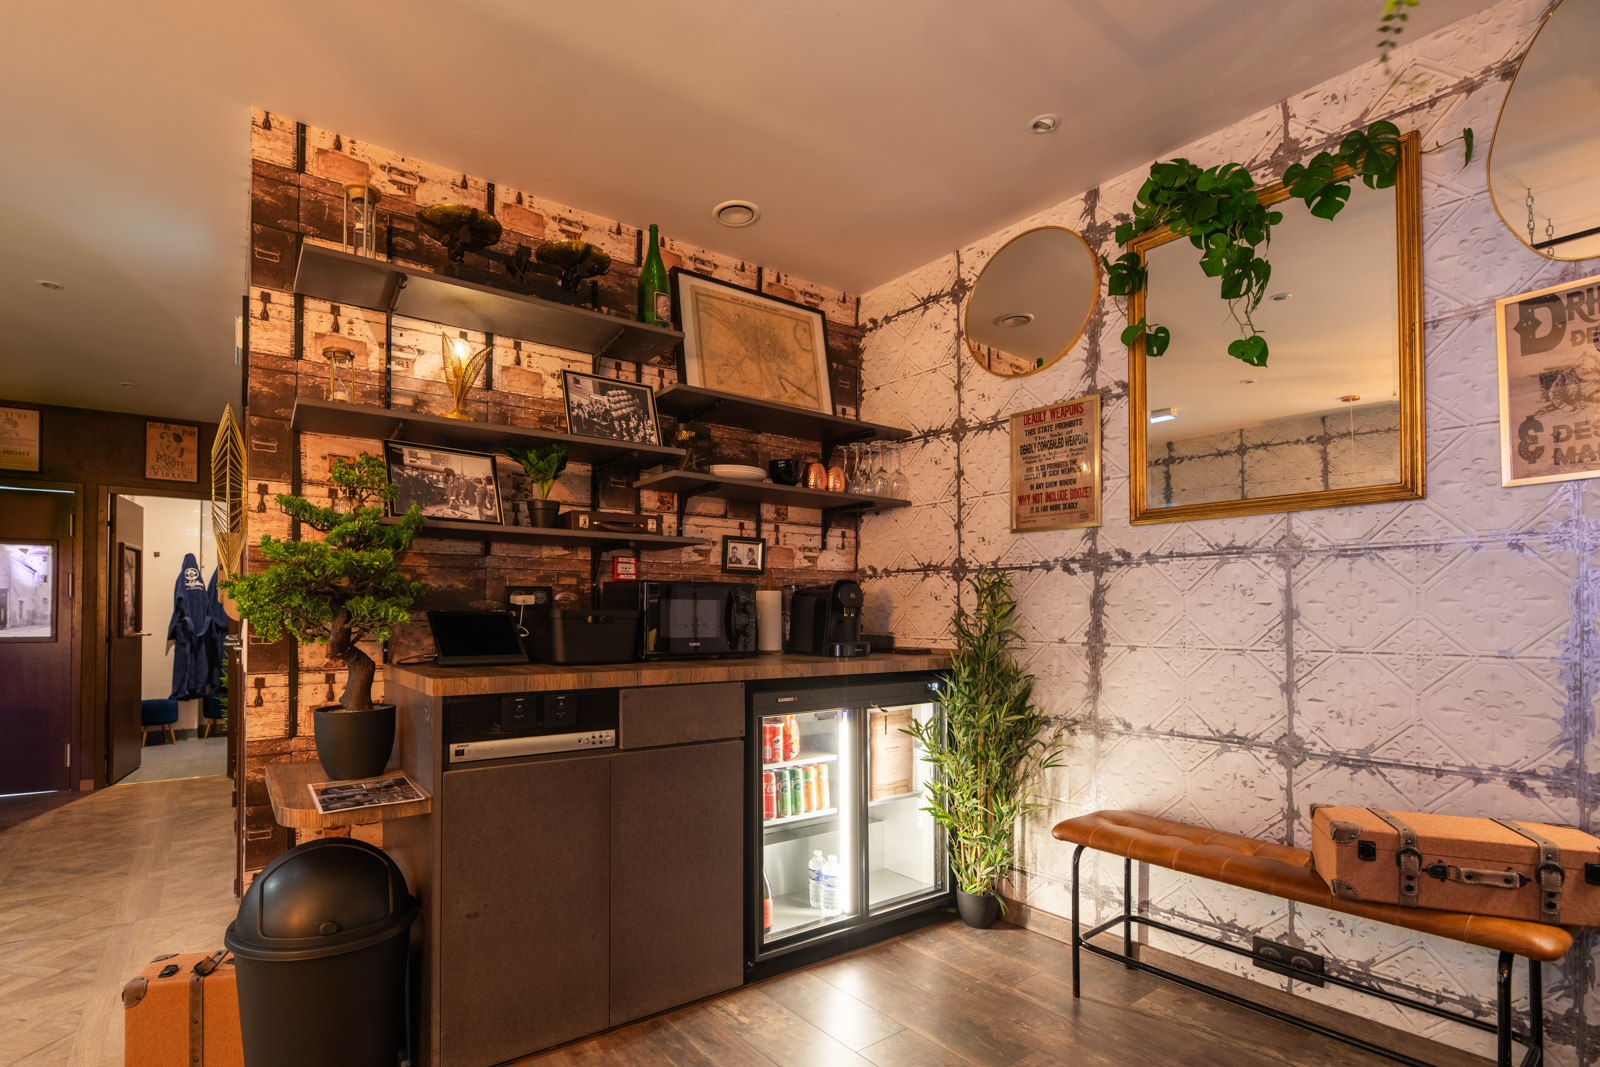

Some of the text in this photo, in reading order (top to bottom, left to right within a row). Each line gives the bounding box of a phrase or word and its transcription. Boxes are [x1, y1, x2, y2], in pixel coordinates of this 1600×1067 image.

[1024, 403, 1084, 426] DEADLY WEAPONS
[182, 429, 196, 437] PURE
[1025, 418, 1083, 437] THIS STATE PROHIBITS
[1037, 437, 1064, 452] CONCEALED
[1065, 432, 1088, 447] WEAPONS
[150, 464, 174, 473] AGAINST
[165, 460, 185, 468] VOTE
[1047, 460, 1068, 470] PROHIBITS
[1069, 458, 1078, 466] THE
[1042, 470, 1047, 478] OF
[1049, 468, 1059, 477] SUCH
[1035, 482, 1044, 490] ANY
[1059, 478, 1077, 487] WINDOW
[1018, 486, 1092, 506] WHY NOT INCLUDE BOOZE?
[1050, 503, 1061, 511] MORE
[1063, 501, 1078, 510] DEADLY
